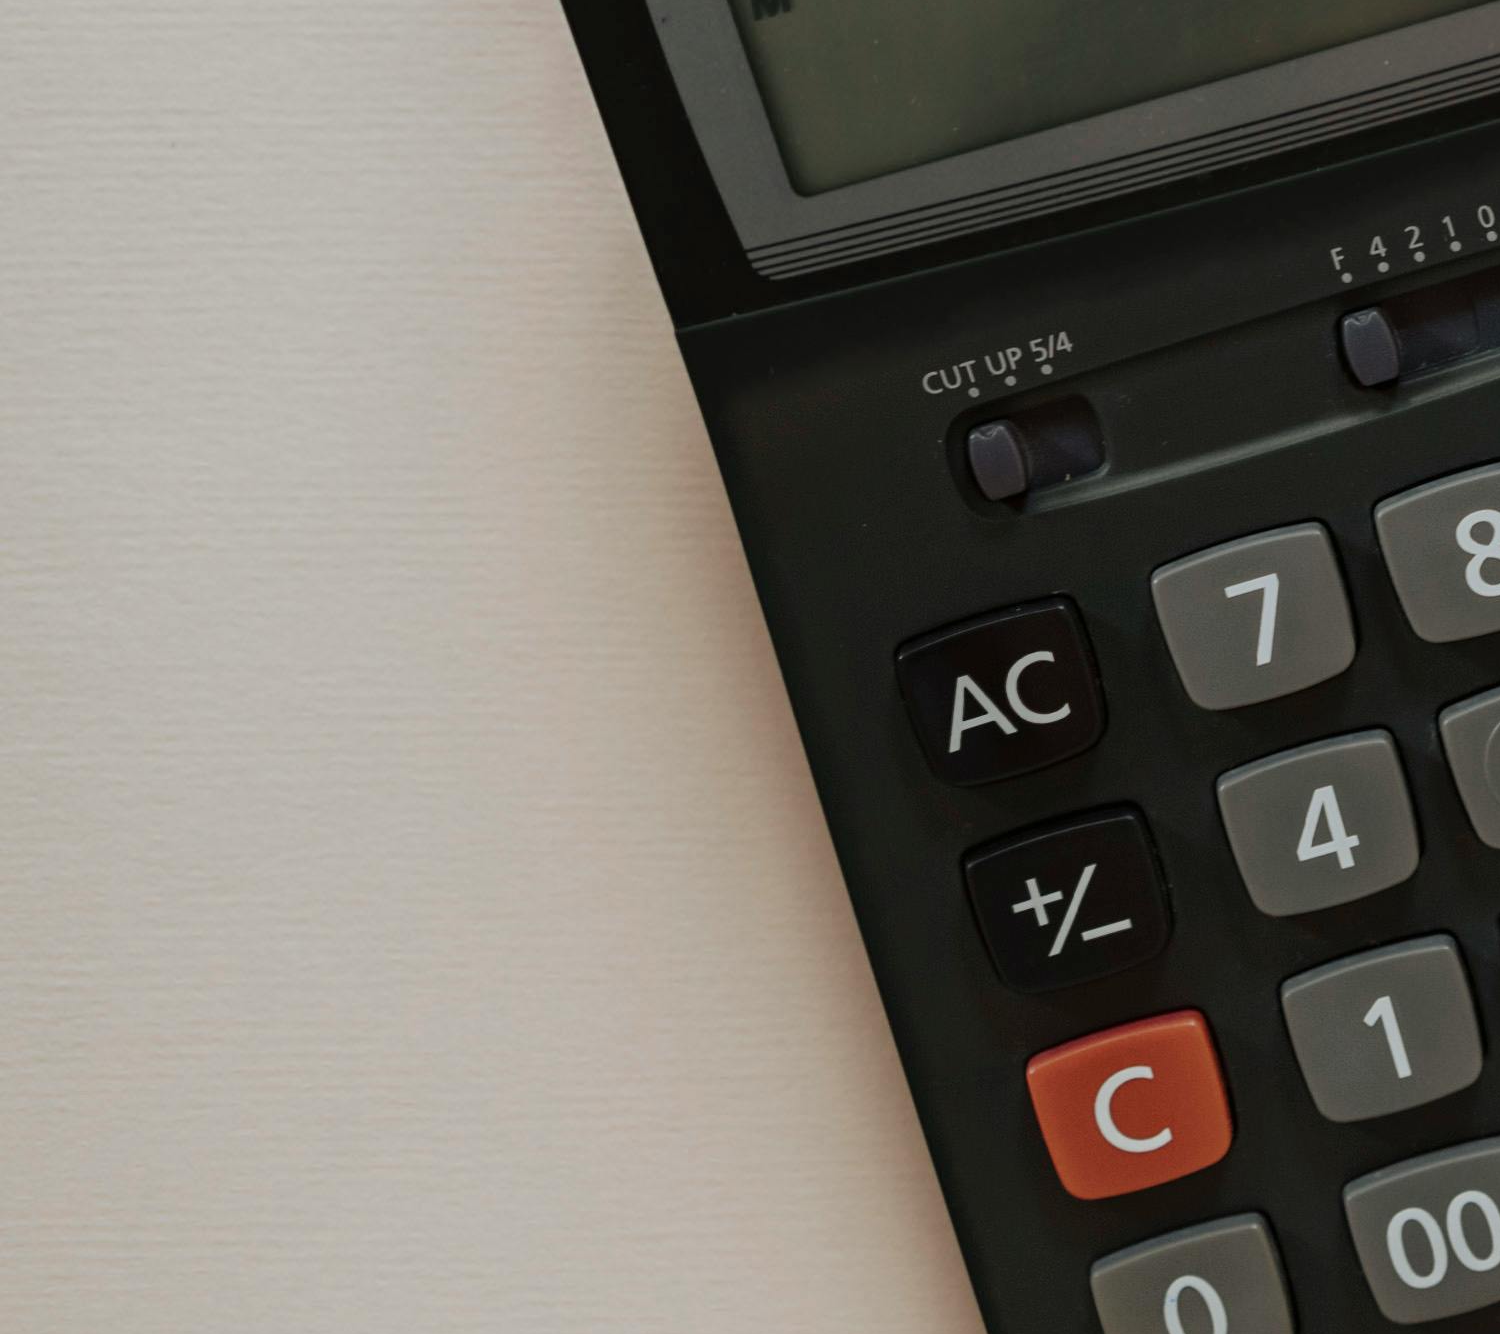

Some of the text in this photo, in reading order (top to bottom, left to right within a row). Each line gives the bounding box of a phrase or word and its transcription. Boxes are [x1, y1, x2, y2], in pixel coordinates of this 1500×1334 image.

[1330, 247, 1347, 270] F
[1367, 235, 1388, 260] 4
[1404, 224, 1426, 250] 2
[1440, 215, 1457, 239] 1
[1475, 204, 1495, 229] 0
[921, 330, 1074, 397] CUT UP 5/4
[1223, 572, 1280, 666] 7
[948, 650, 1071, 753] AC
[1296, 784, 1360, 870] 4
[1363, 995, 1412, 1079] 1
[1094, 1065, 1173, 1153] C
